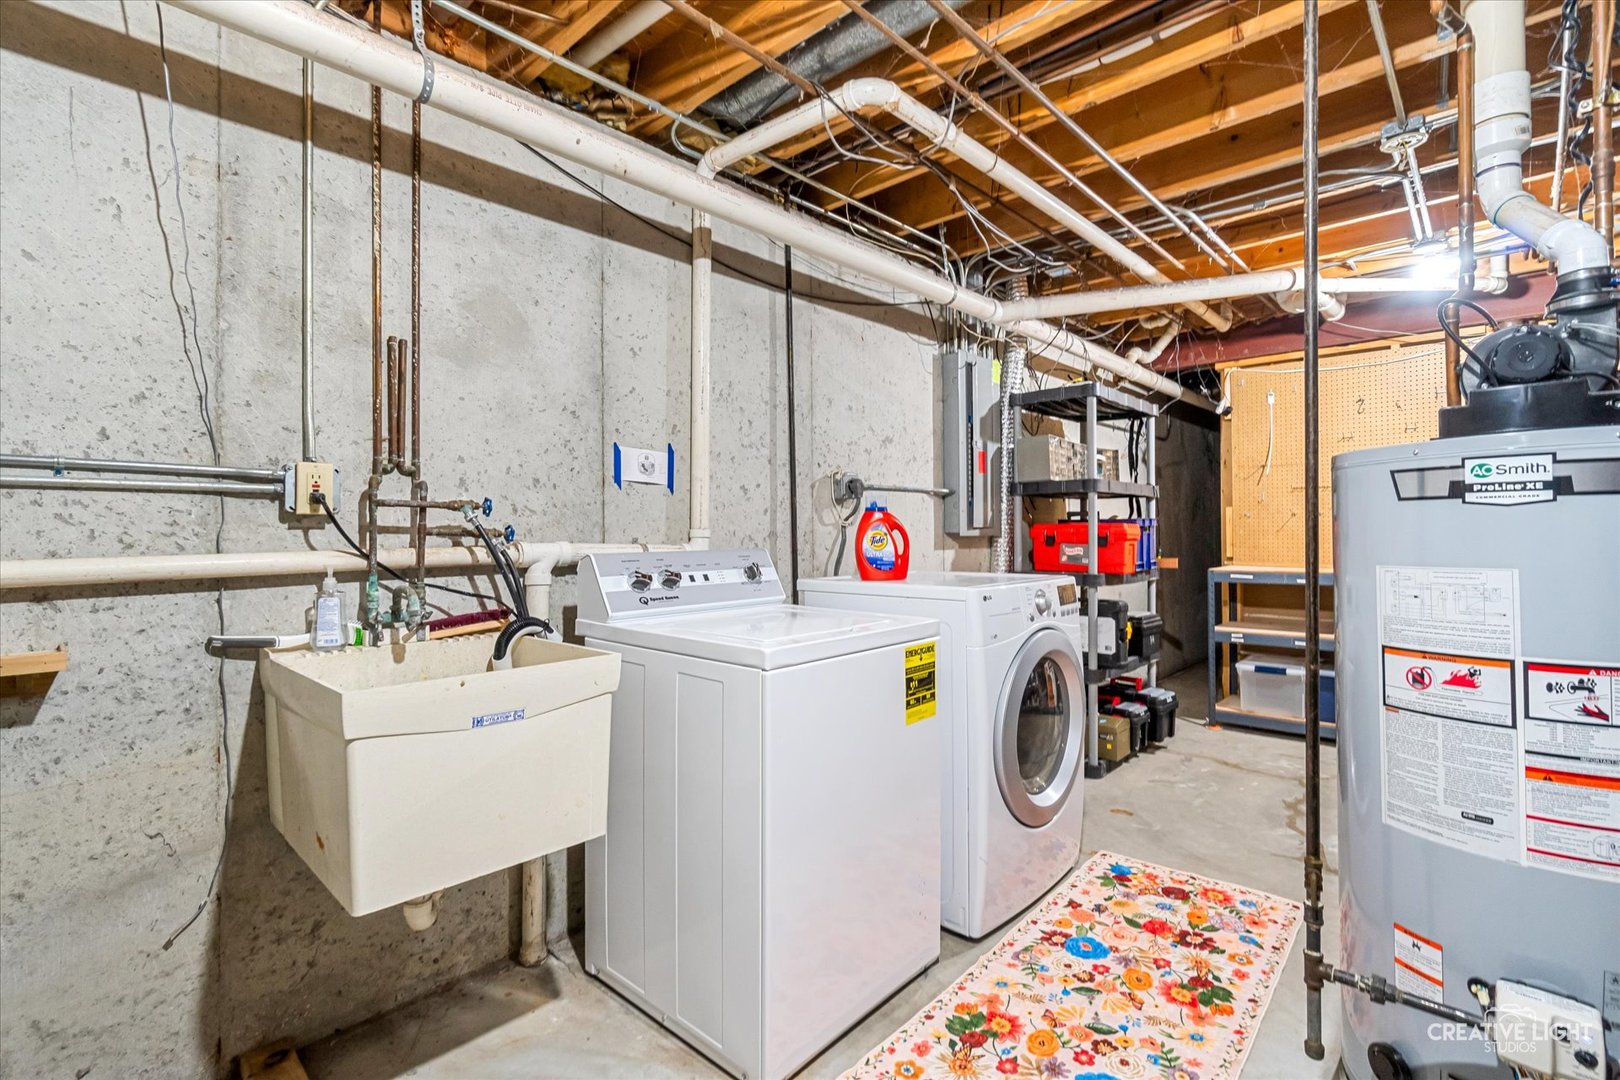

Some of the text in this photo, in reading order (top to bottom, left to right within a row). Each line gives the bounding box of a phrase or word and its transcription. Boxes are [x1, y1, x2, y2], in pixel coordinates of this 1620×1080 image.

[1496, 462, 1547, 475] Smith
[1526, 481, 1544, 490] XE
[870, 535, 885, 546] Tide
